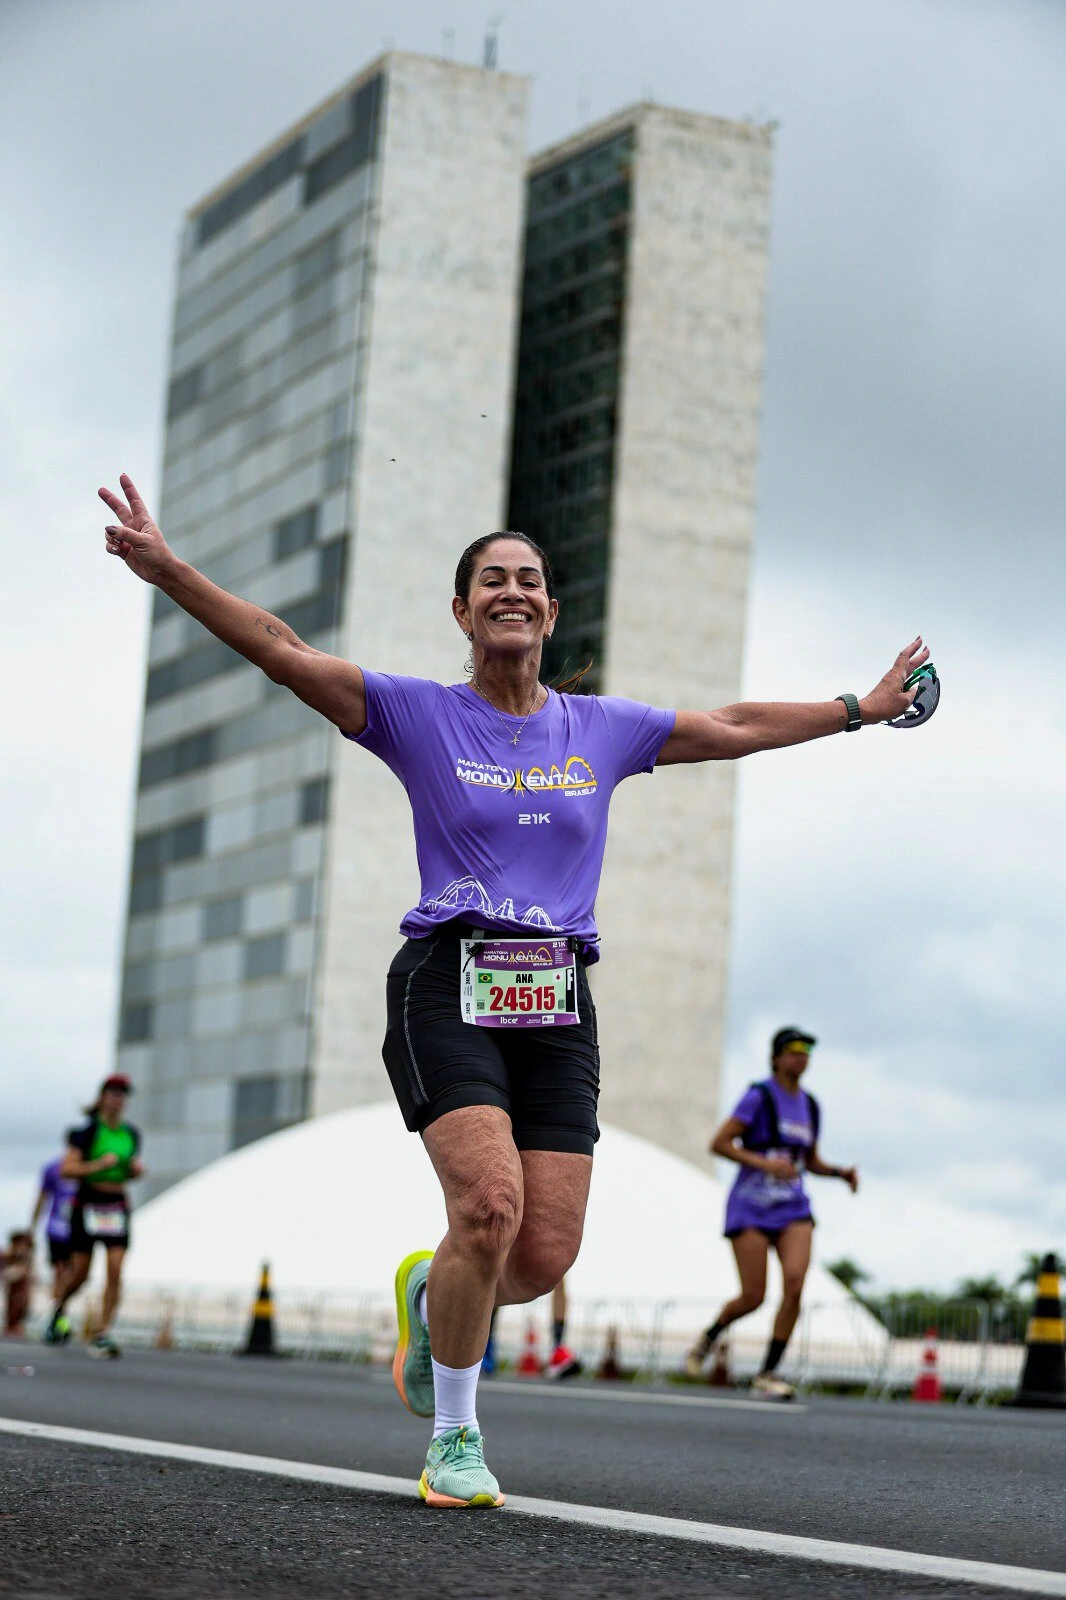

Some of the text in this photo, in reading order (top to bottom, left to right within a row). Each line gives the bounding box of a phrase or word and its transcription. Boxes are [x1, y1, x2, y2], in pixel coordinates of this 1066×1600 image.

[457, 758, 508, 773] MARATONA
[518, 812, 551, 825] 21K
[515, 973, 533, 984] ANA
[489, 985, 556, 1012] 24515
